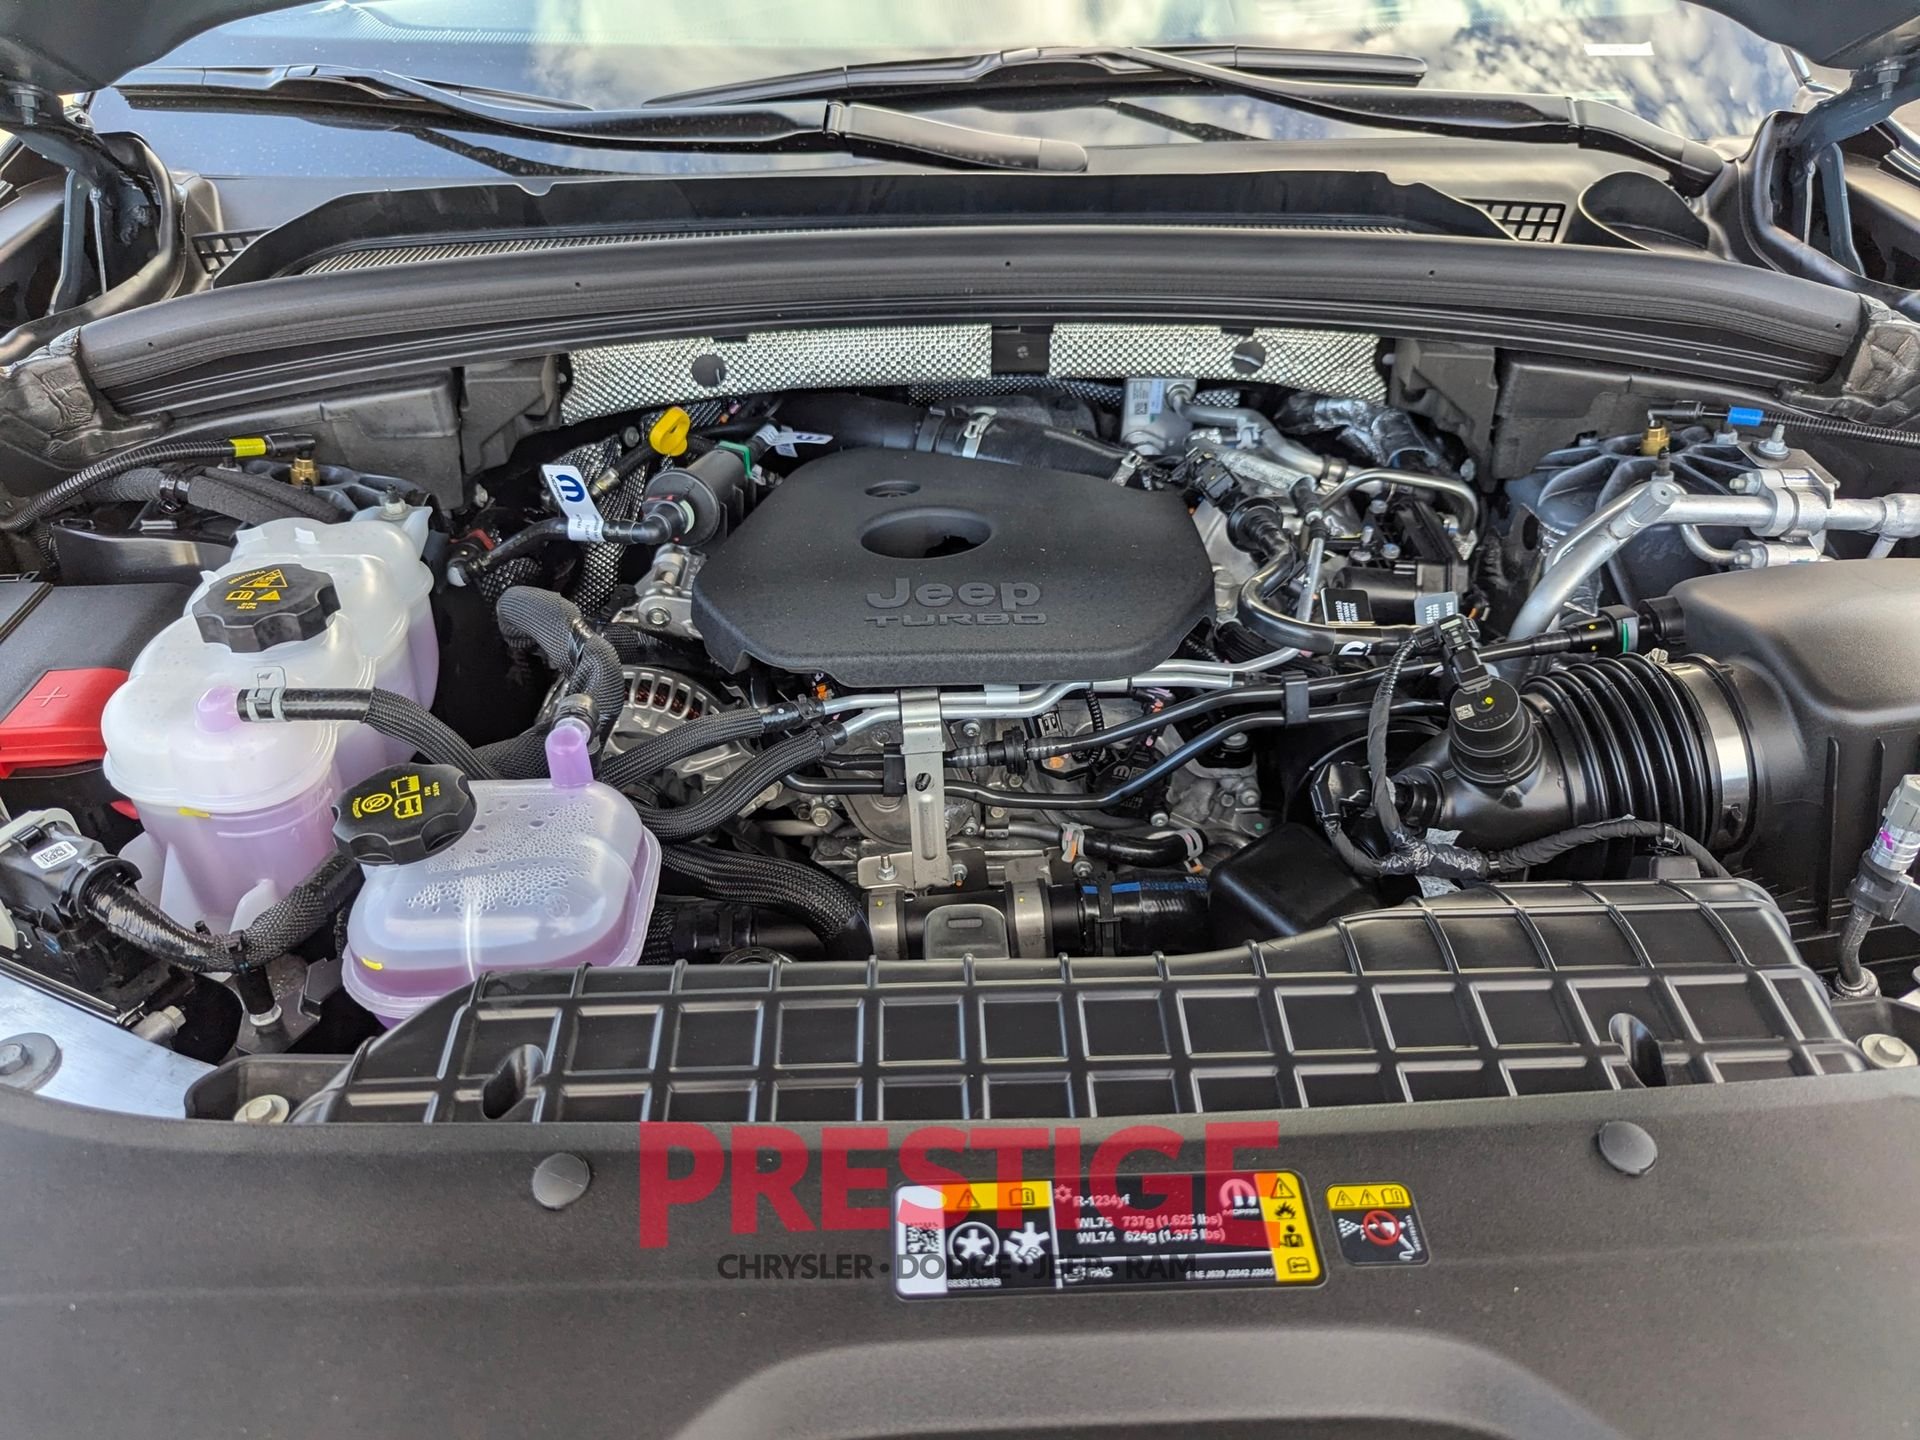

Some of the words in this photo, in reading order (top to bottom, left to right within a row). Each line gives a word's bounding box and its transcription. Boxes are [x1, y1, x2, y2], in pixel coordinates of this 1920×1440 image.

[866, 577, 1041, 612] Jeep
[864, 612, 1047, 628] TURBO
[1075, 1217, 1113, 1230] WL75
[1121, 1215, 1155, 1229] 737g
[1156, 1214, 1196, 1229] (1.625
[1197, 1213, 1223, 1228] lbs)
[1077, 1231, 1116, 1245] WL74
[1123, 1230, 1158, 1245] 624g
[1158, 1229, 1199, 1244] (1.375
[1199, 1227, 1226, 1242] lbs)
